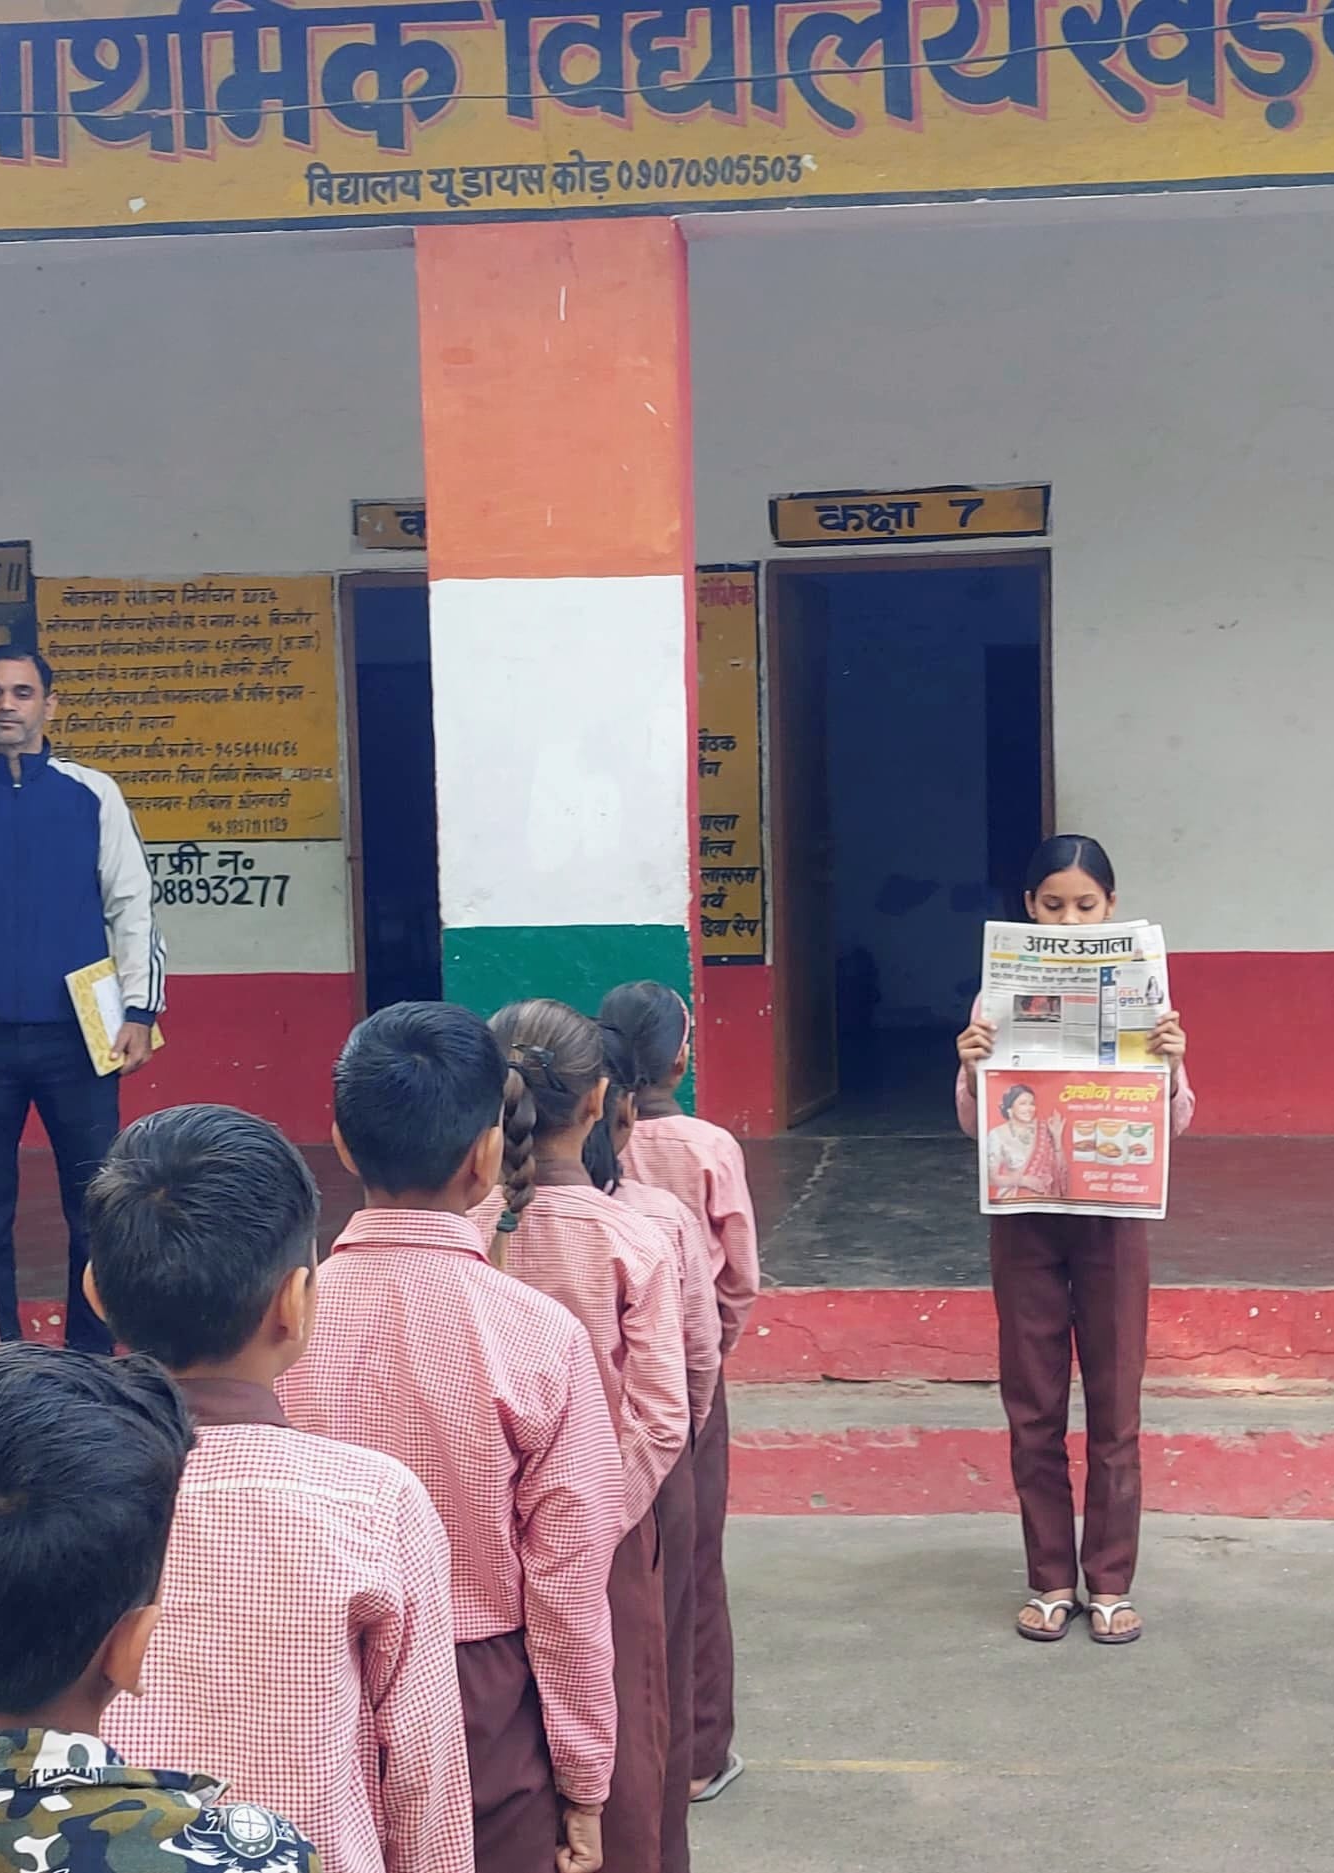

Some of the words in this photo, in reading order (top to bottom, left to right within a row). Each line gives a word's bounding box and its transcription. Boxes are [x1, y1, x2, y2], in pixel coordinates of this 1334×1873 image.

[305, 162, 423, 206] विद्यालय
[553, 149, 612, 200] कोड़
[616, 154, 804, 191] 09070905503
[814, 501, 922, 535] कक्षा
[949, 498, 985, 529] 7
[181, 582, 236, 604] निर्वाचन
[168, 842, 210, 876] फ्री
[152, 875, 291, 907] 08893277
[1023, 935, 1069, 954] अमर
[1071, 936, 1134, 955] उजाला
